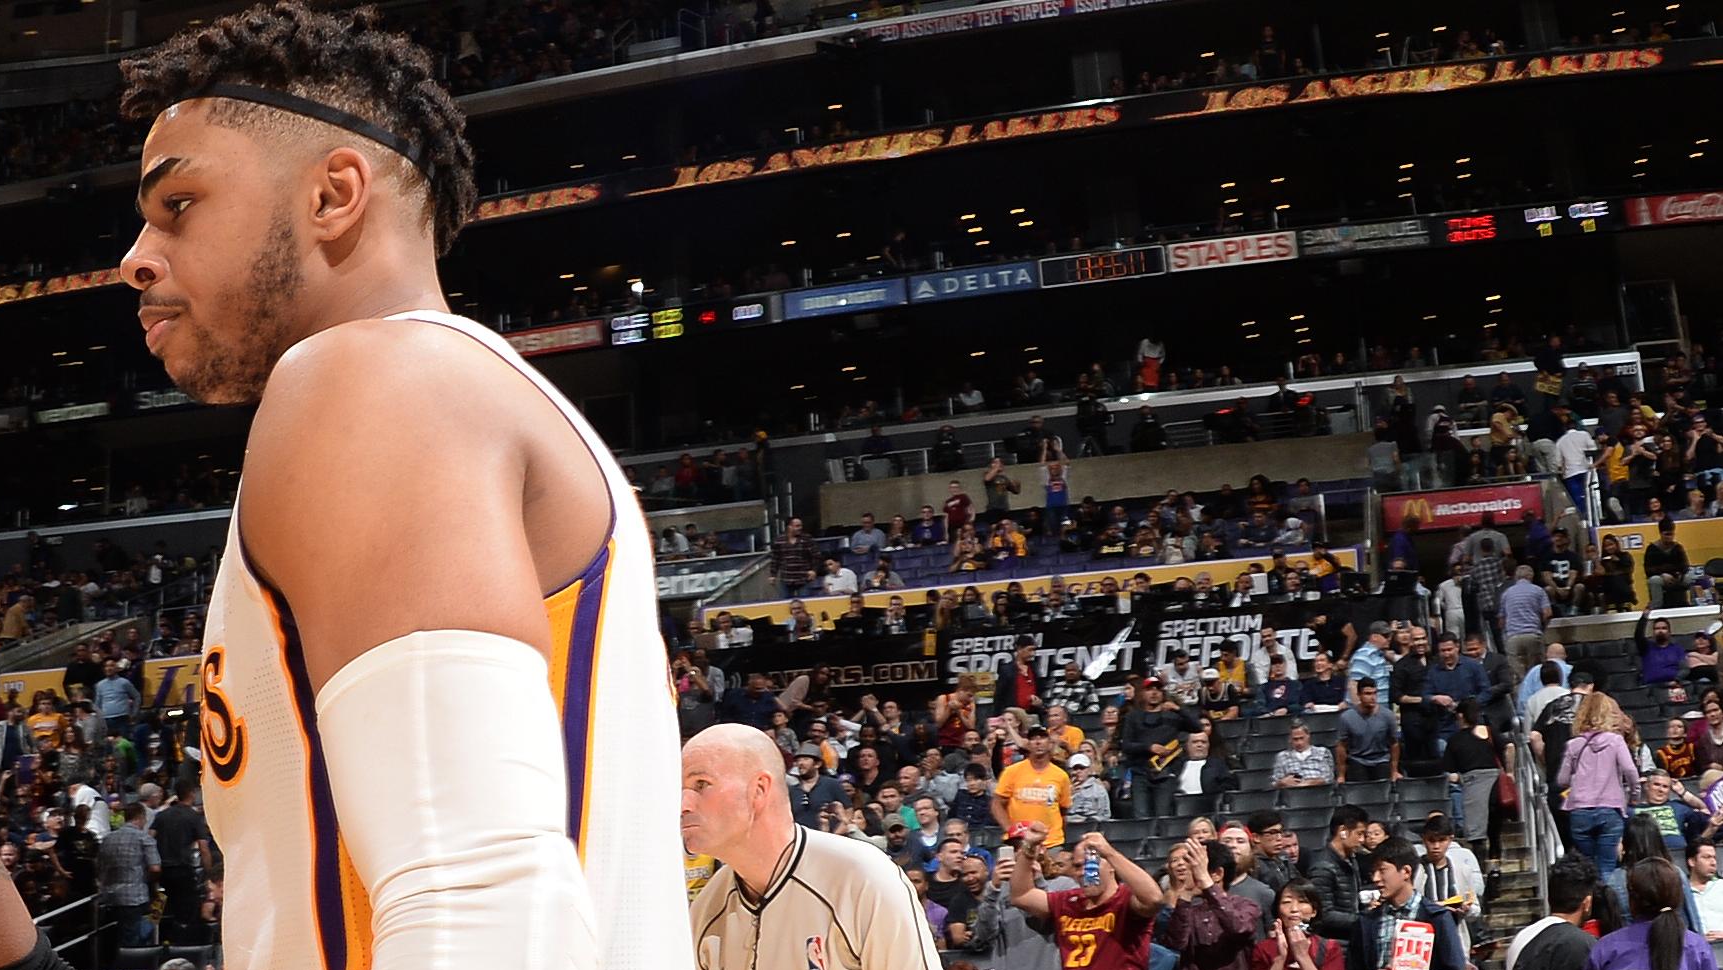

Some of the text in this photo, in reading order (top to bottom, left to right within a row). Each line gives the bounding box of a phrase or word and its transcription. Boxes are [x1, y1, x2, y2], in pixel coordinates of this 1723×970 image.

[1172, 233, 1294, 269] STAPLES
[943, 267, 1033, 294] DELTA
[1436, 498, 1523, 517] McDonald's
[656, 567, 741, 597] erizo
[1159, 613, 1264, 639] SPECTRUM
[950, 632, 1044, 655] SPECTRM
[1065, 933, 1097, 967] 23
